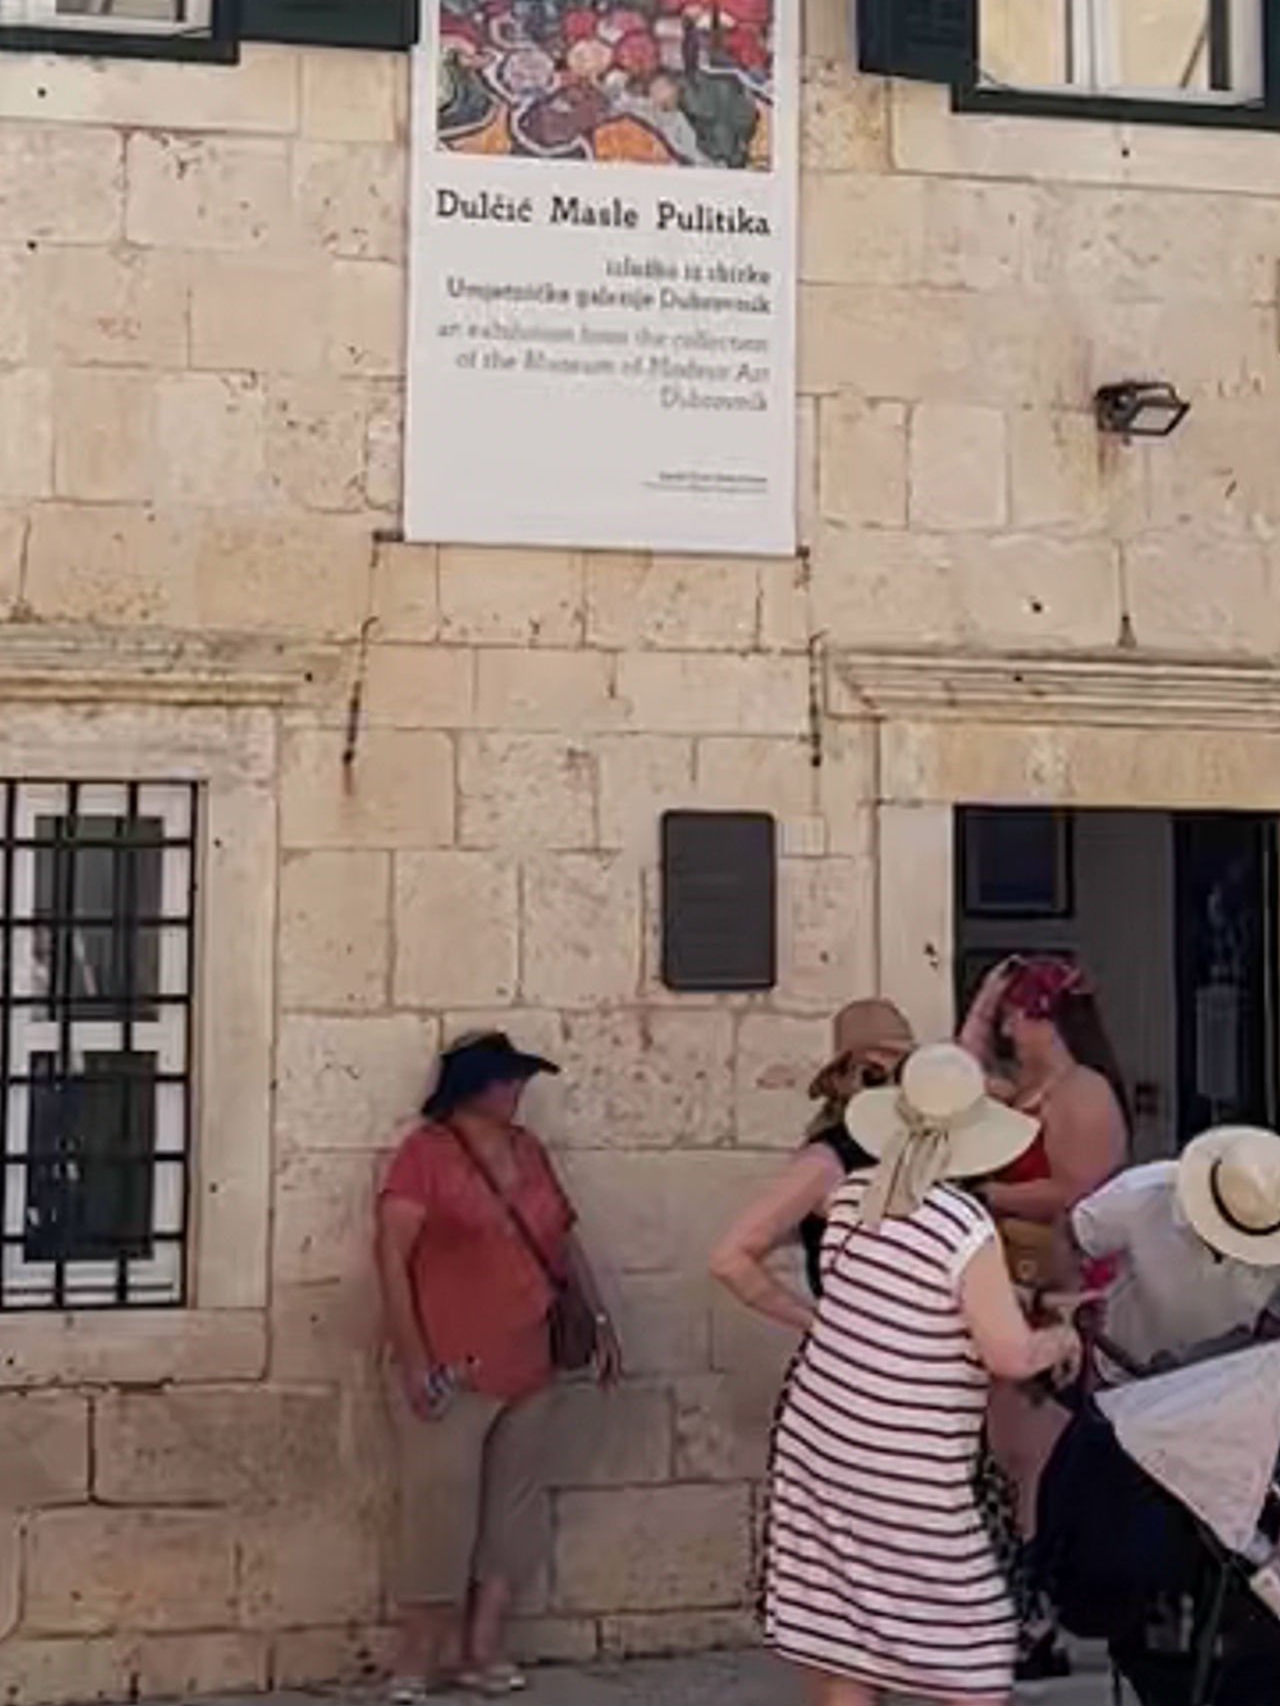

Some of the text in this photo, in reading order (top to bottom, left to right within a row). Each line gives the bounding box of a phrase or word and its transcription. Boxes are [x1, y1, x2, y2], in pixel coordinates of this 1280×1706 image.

[436, 189, 771, 236] Dulčić Masle Pulitika
